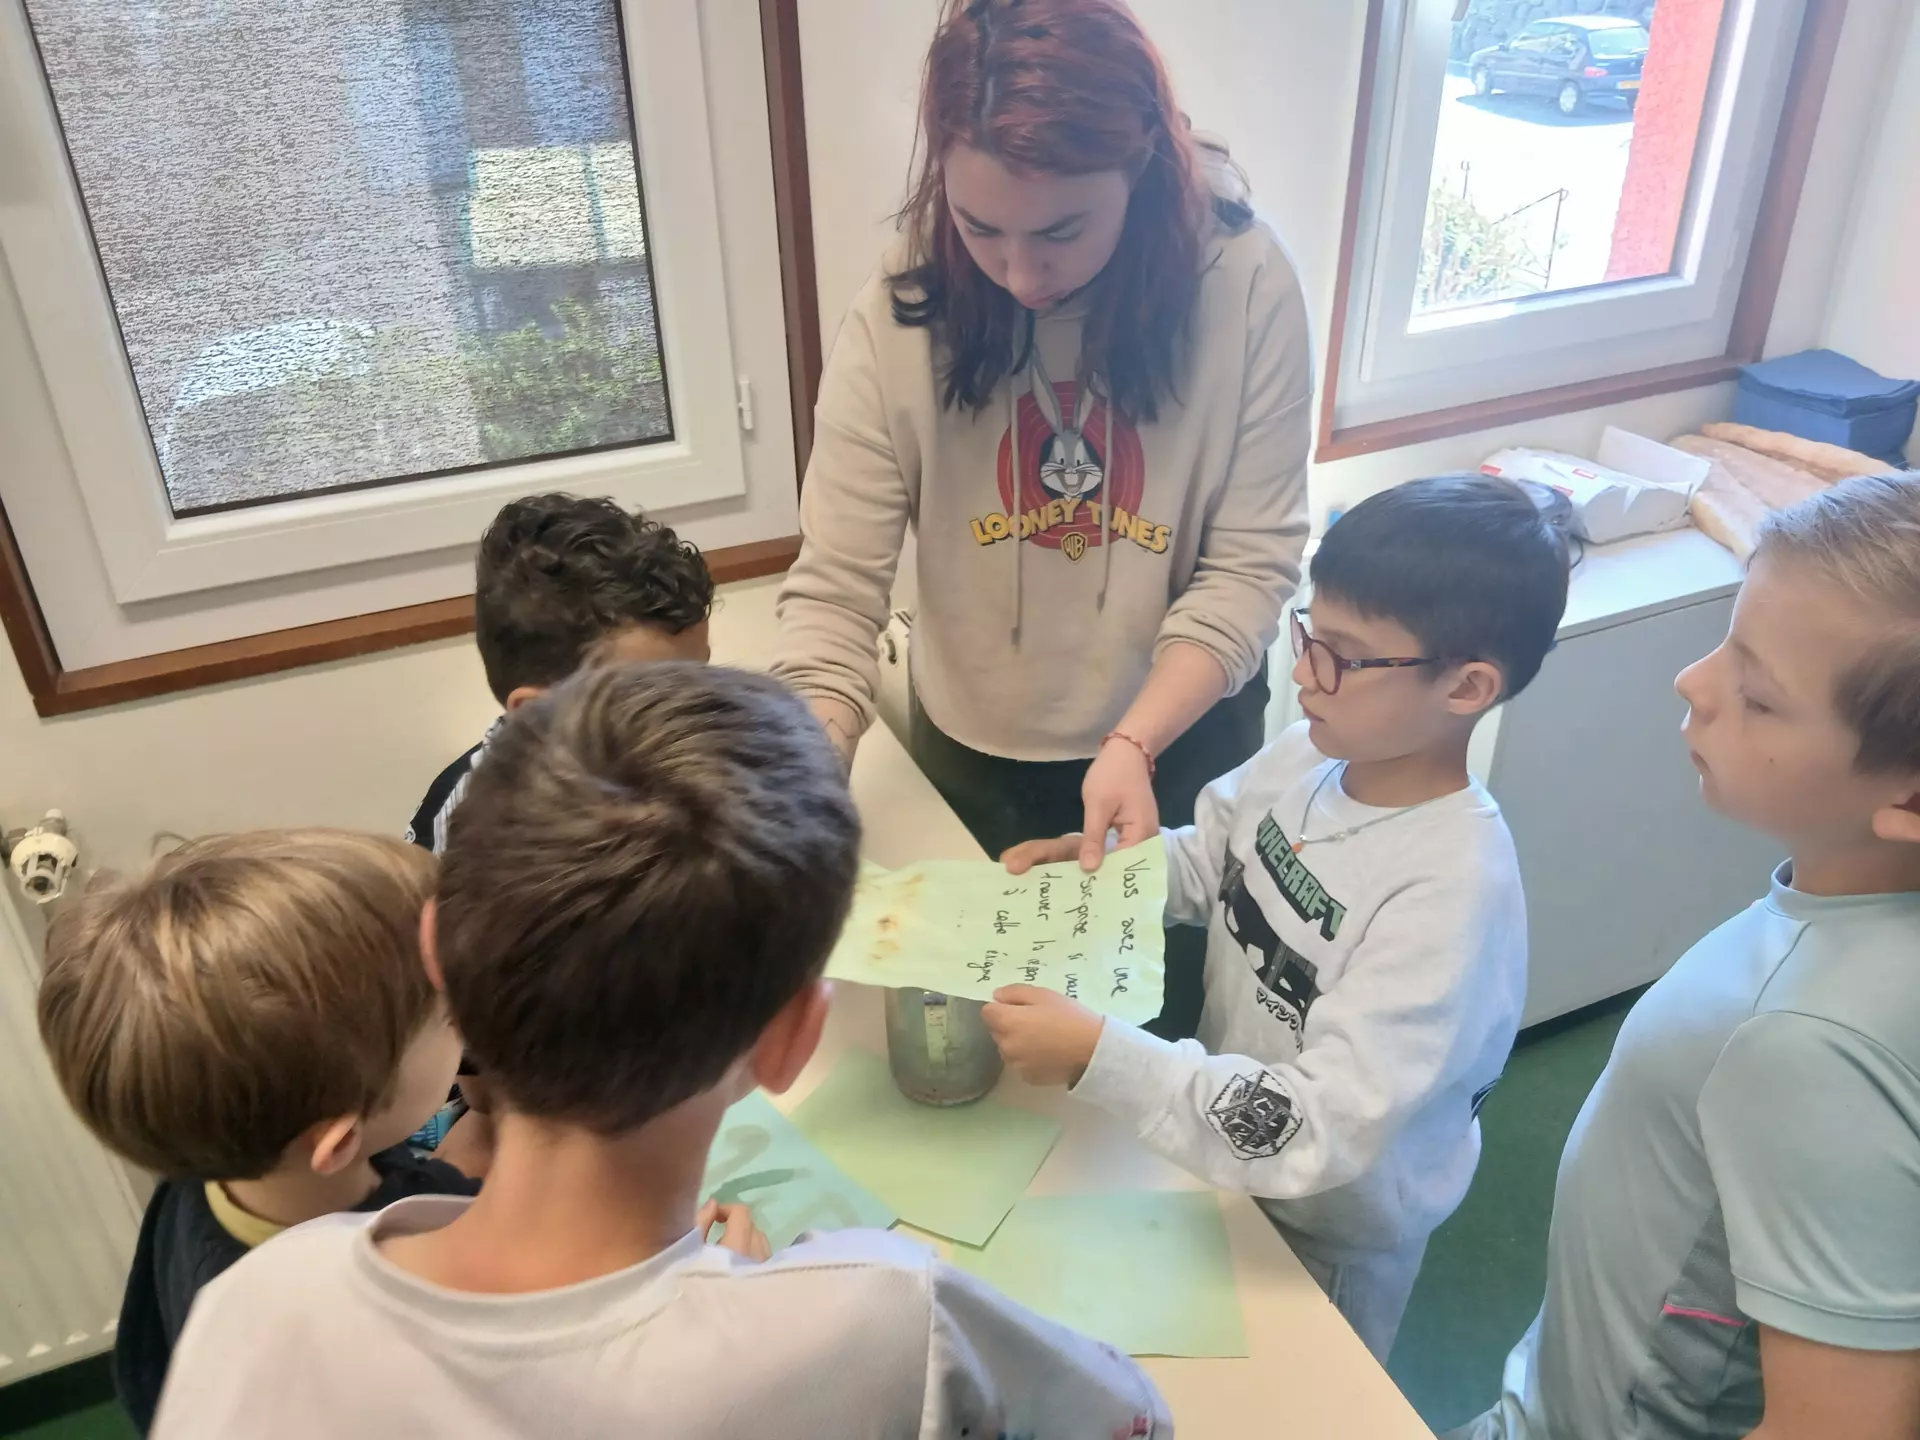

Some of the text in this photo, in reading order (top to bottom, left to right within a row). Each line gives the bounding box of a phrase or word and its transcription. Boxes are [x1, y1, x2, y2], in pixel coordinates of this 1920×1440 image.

[969, 497, 1082, 546] LOONEY
[1063, 533, 1086, 562] WB
[1256, 809, 1347, 941] INECRAFT
[993, 910, 1021, 934] cette
[1017, 873, 1062, 981] trouver la répon
[1110, 859, 1150, 998] Vous avez une
[1256, 987, 1303, 1053] マインク
